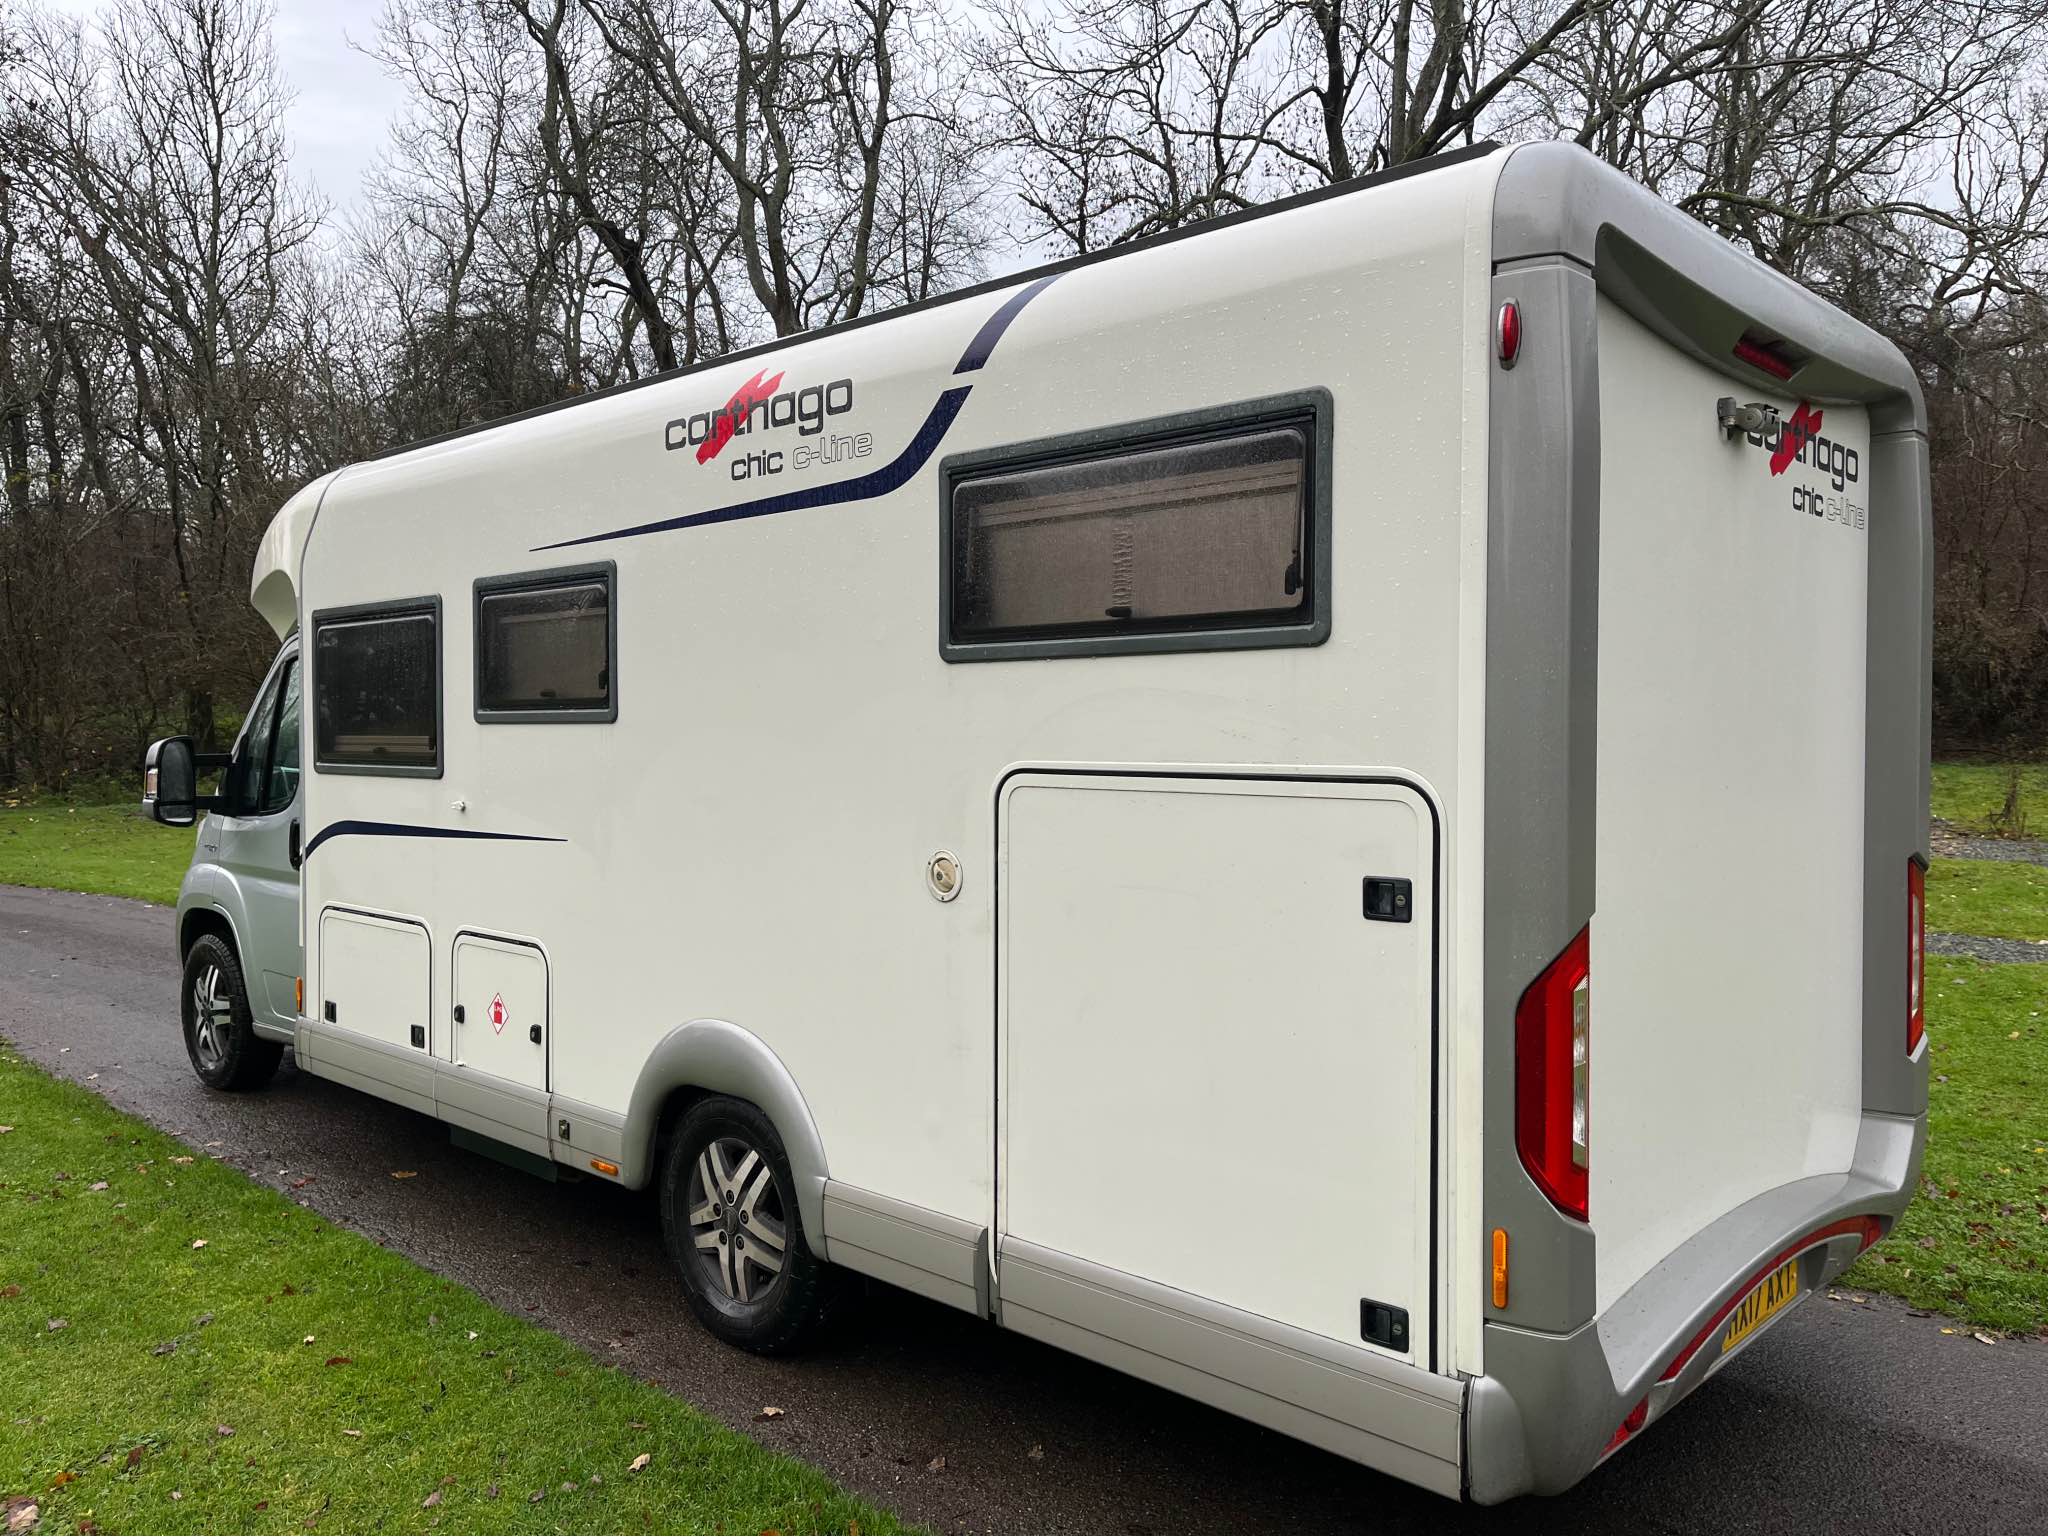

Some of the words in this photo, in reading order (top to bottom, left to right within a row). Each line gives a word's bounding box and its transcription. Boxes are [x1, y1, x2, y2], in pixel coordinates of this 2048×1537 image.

[665, 378, 853, 451] carthago
[731, 450, 784, 481] chic
[793, 432, 873, 470] c-line
[1792, 484, 1824, 518] chic
[1826, 497, 1865, 530] c-line
